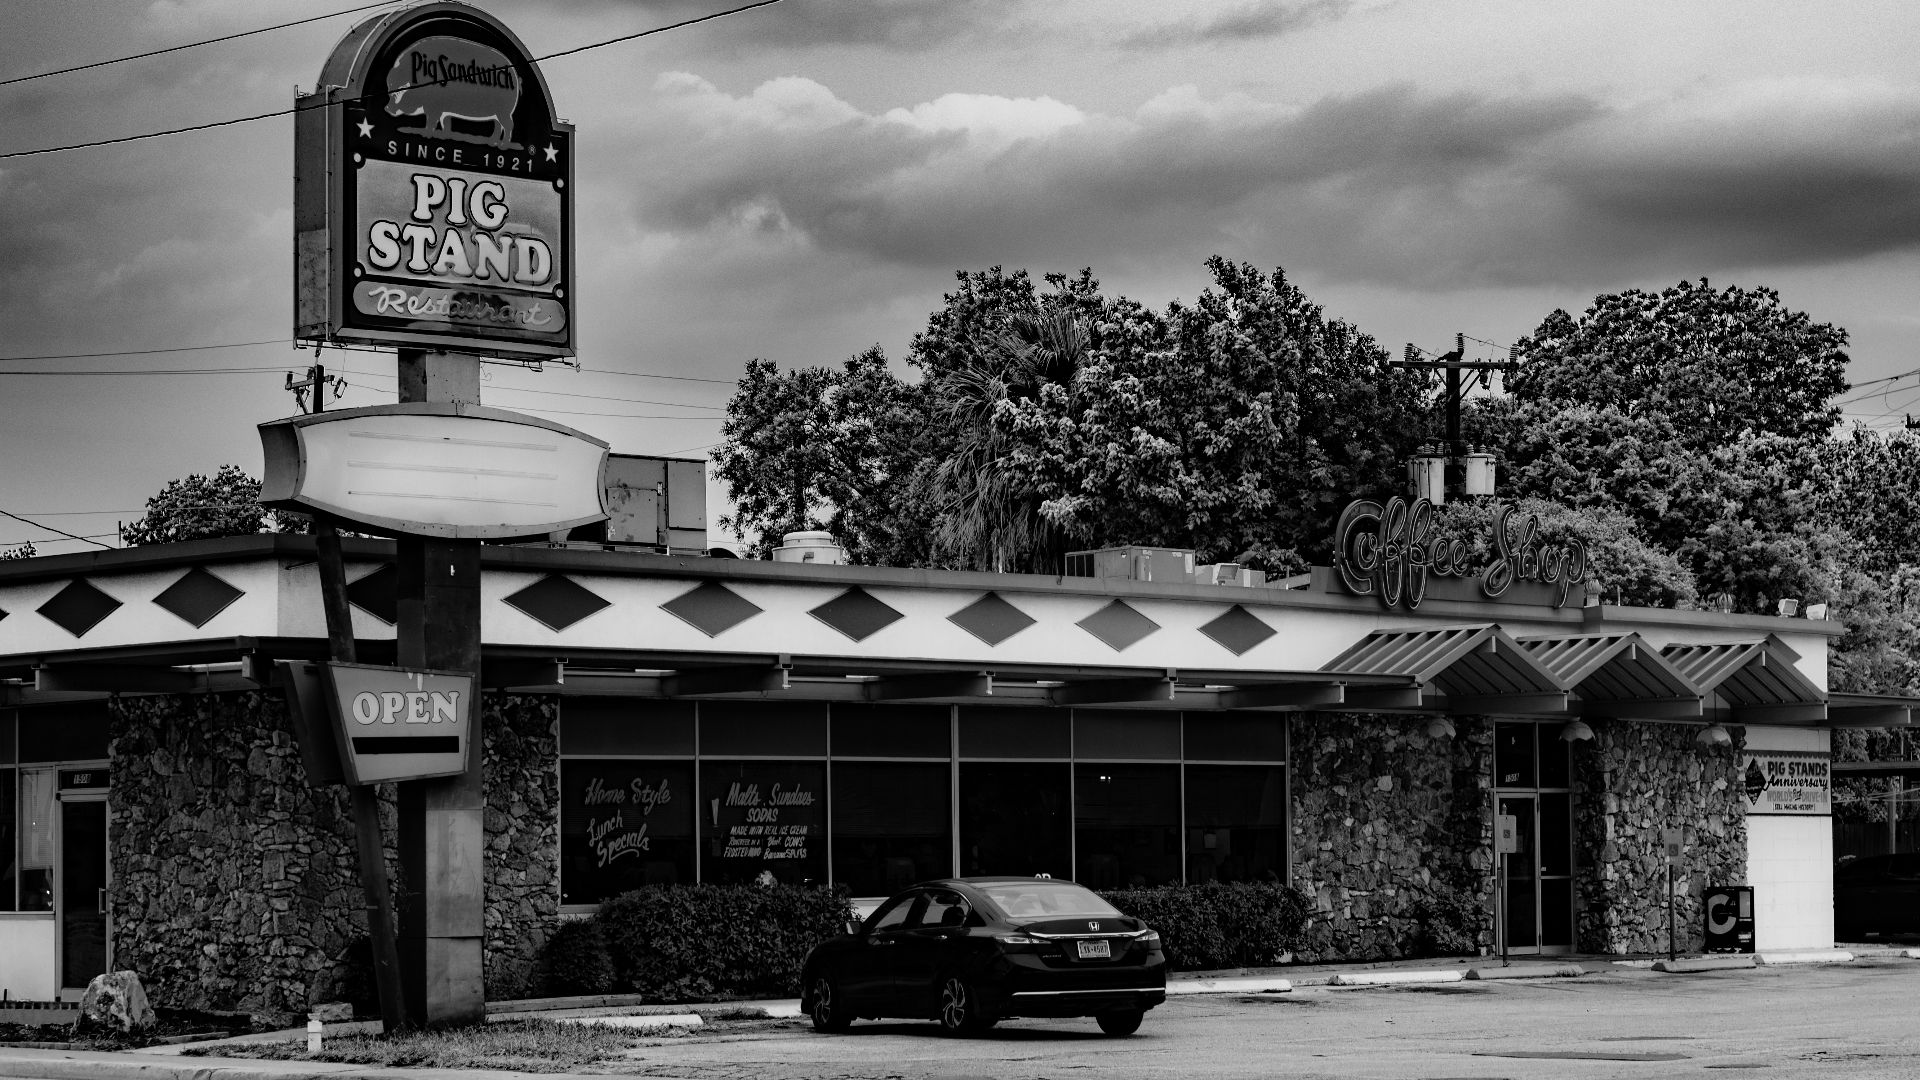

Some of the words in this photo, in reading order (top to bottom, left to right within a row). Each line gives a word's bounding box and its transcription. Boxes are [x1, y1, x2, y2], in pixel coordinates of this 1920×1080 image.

[388, 140, 463, 164] SINCE
[483, 153, 533, 173] 1921
[411, 173, 509, 230] PIG
[368, 219, 552, 285] STAND
[368, 286, 551, 325] Restaurant
[1335, 496, 1468, 610] Coffee
[1479, 504, 1586, 609] Shop
[352, 691, 460, 725] OPEN
[1762, 774, 1828, 792] Anniversary
[1767, 761, 1785, 776] PIG
[1788, 761, 1827, 777] STANDS
[584, 777, 626, 806] Home
[630, 777, 671, 815] Style
[769, 782, 815, 807] Sundaes
[586, 808, 623, 848] Lunch
[746, 808, 778, 823] SODAS
[596, 822, 650, 868] Specials
